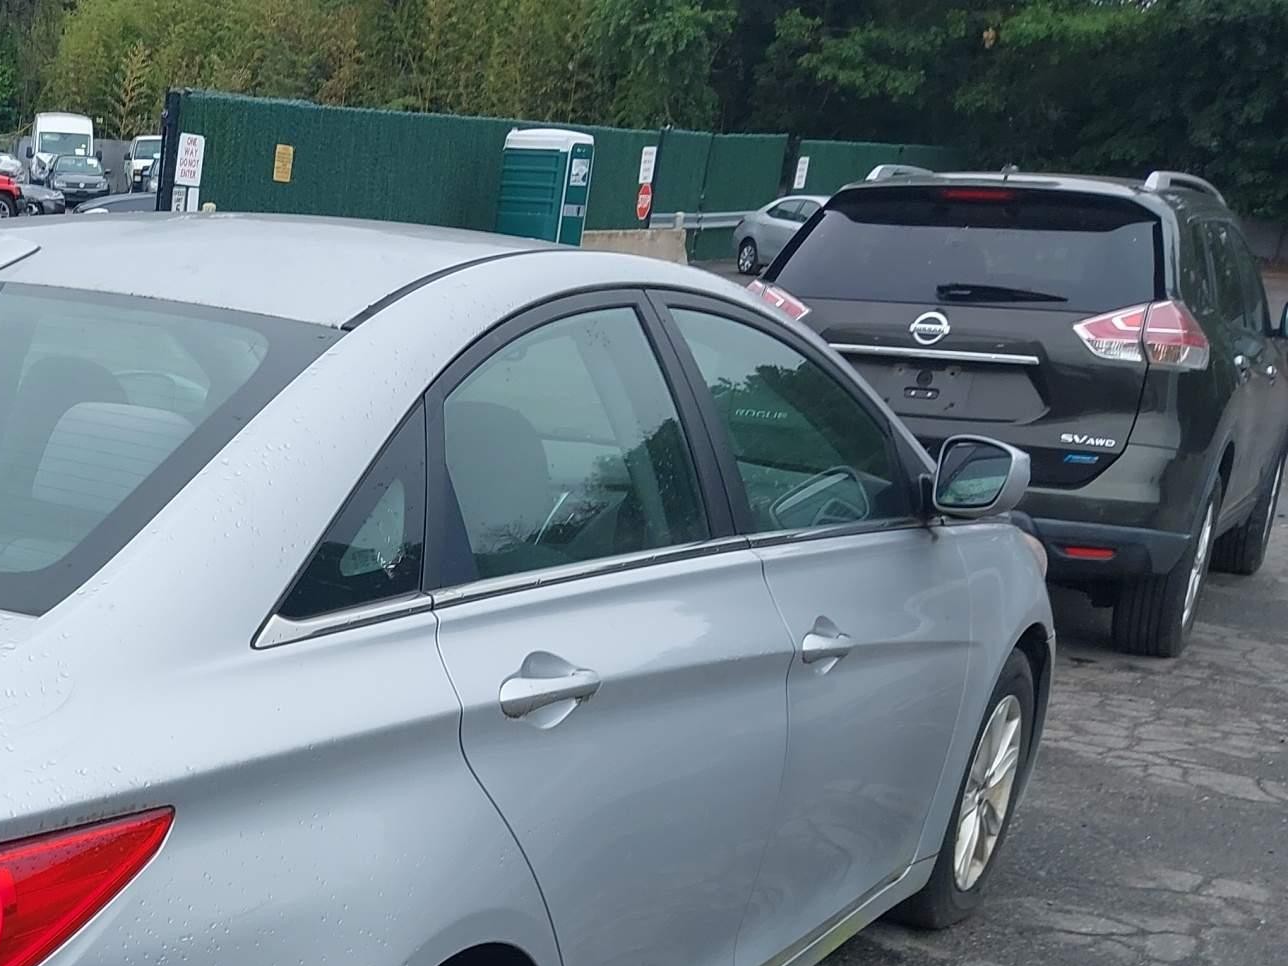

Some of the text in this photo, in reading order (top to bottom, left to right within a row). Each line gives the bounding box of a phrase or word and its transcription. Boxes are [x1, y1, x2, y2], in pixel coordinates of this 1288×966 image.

[187, 136, 197, 147] ONE
[185, 147, 198, 156] WAY
[179, 159, 199, 168] DO NOT
[180, 169, 196, 179] ENTER
[1060, 433, 1116, 447] SV AWD
